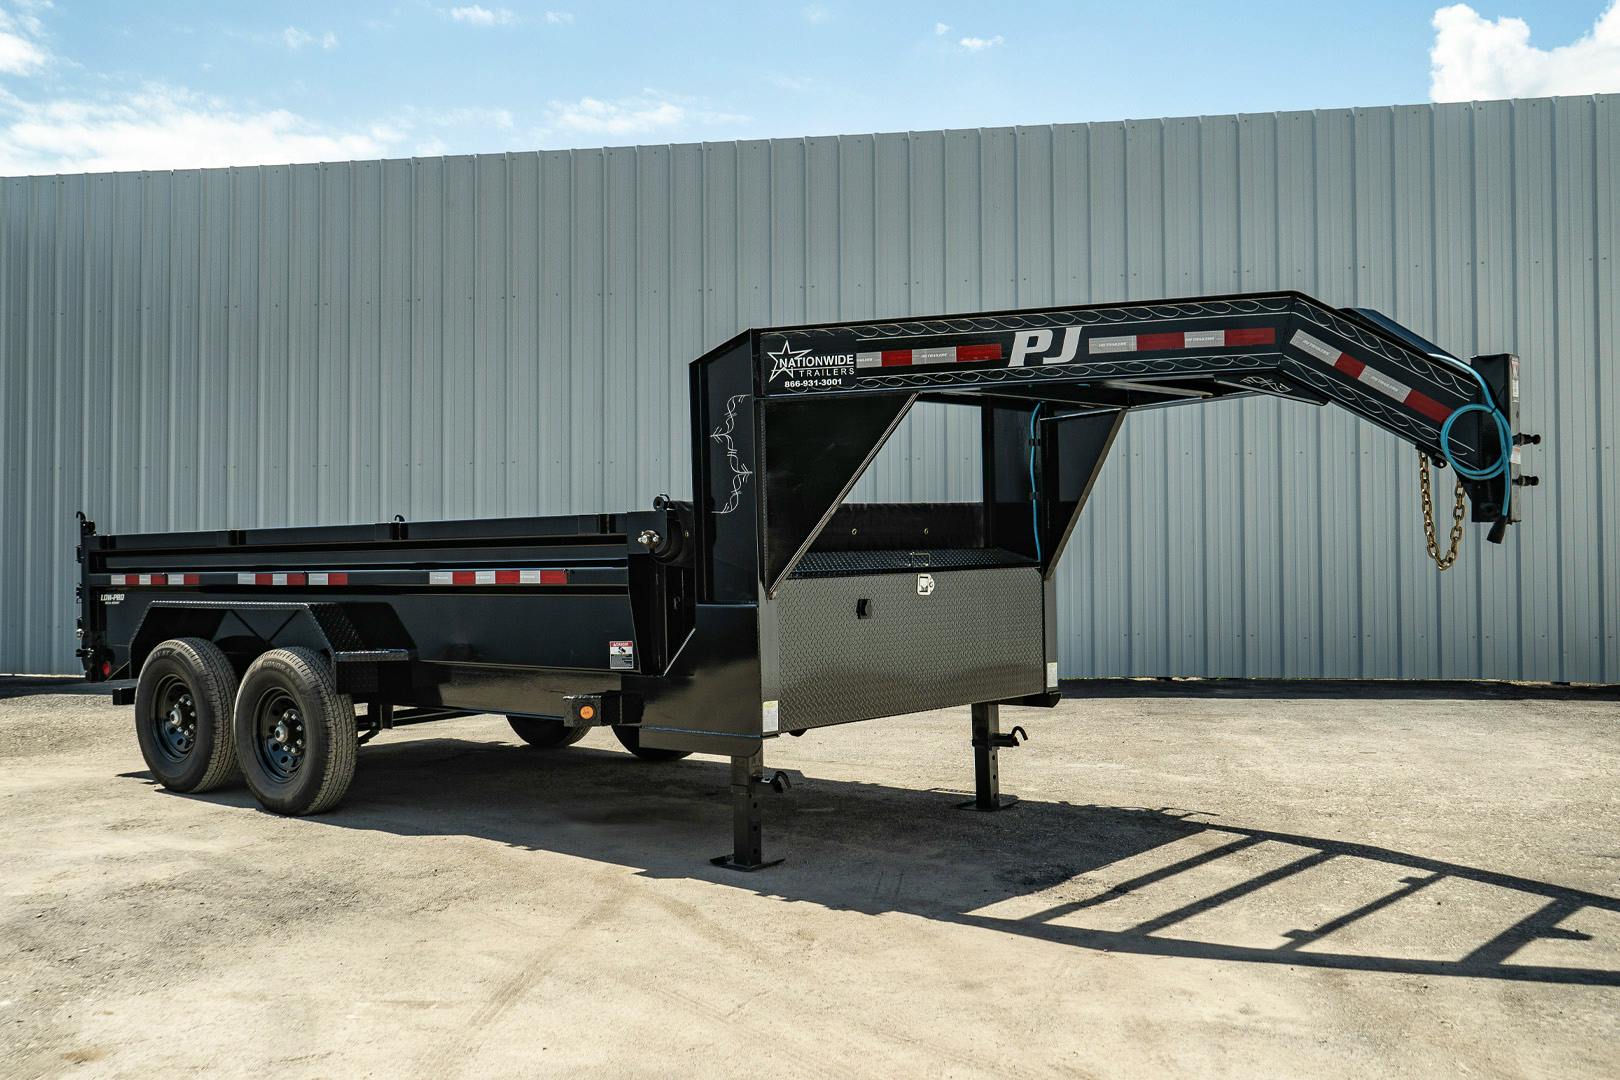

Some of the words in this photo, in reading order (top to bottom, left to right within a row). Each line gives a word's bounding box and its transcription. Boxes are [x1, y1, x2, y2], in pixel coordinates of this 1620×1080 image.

[1007, 325, 1083, 368] PJ
[779, 354, 855, 369] NATIONWIDE
[798, 367, 855, 378] TRAILERS
[784, 378, 842, 388] 866-931-3001
